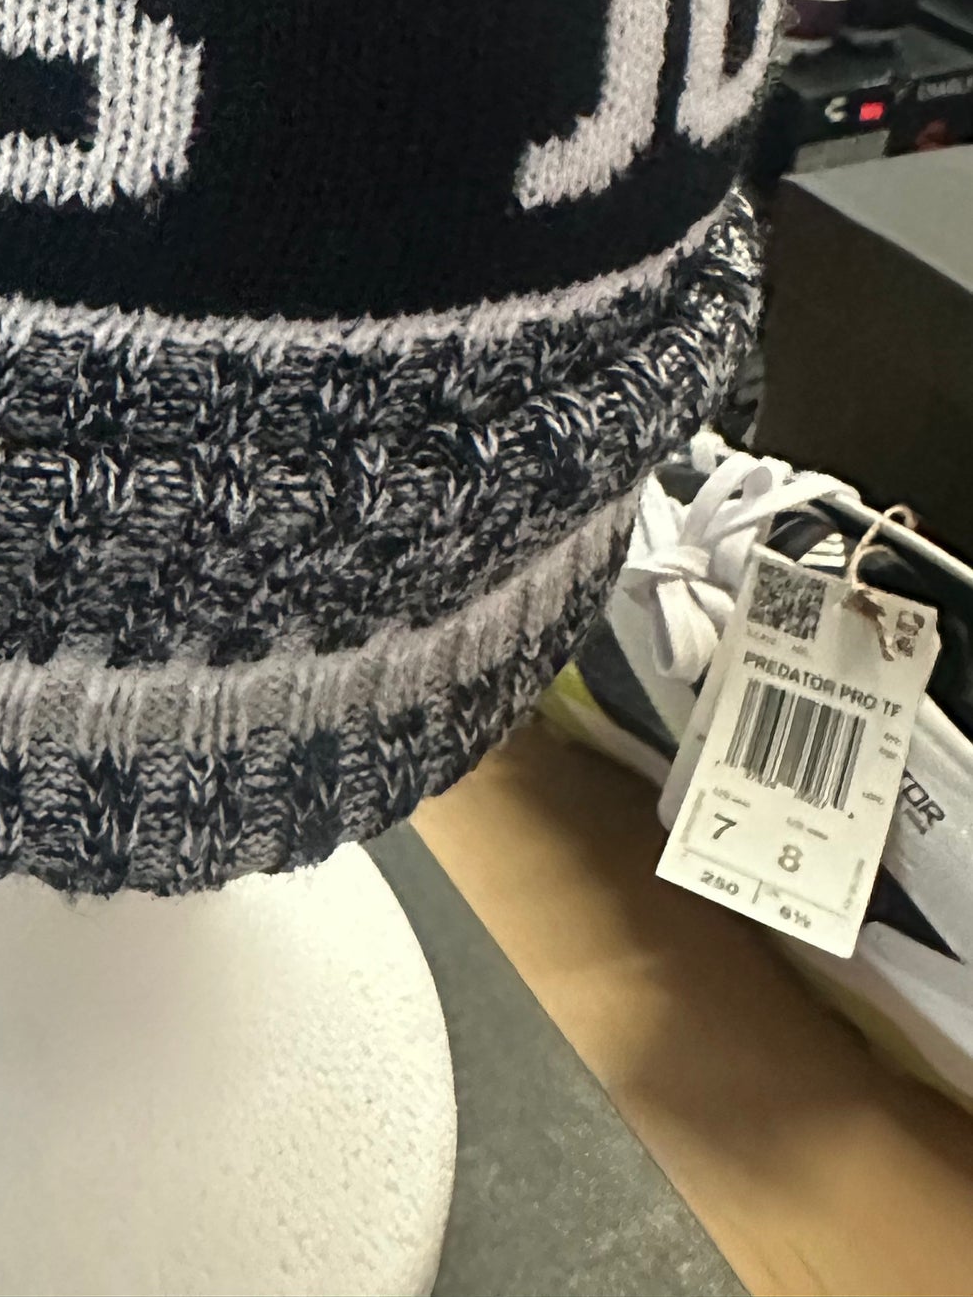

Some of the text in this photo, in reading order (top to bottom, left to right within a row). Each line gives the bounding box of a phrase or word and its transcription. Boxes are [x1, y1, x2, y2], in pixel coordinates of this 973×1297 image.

[743, 651, 836, 696] PREDATOR
[840, 683, 878, 710] PRO
[713, 813, 803, 873] 7 8
[700, 871, 740, 896] 250
